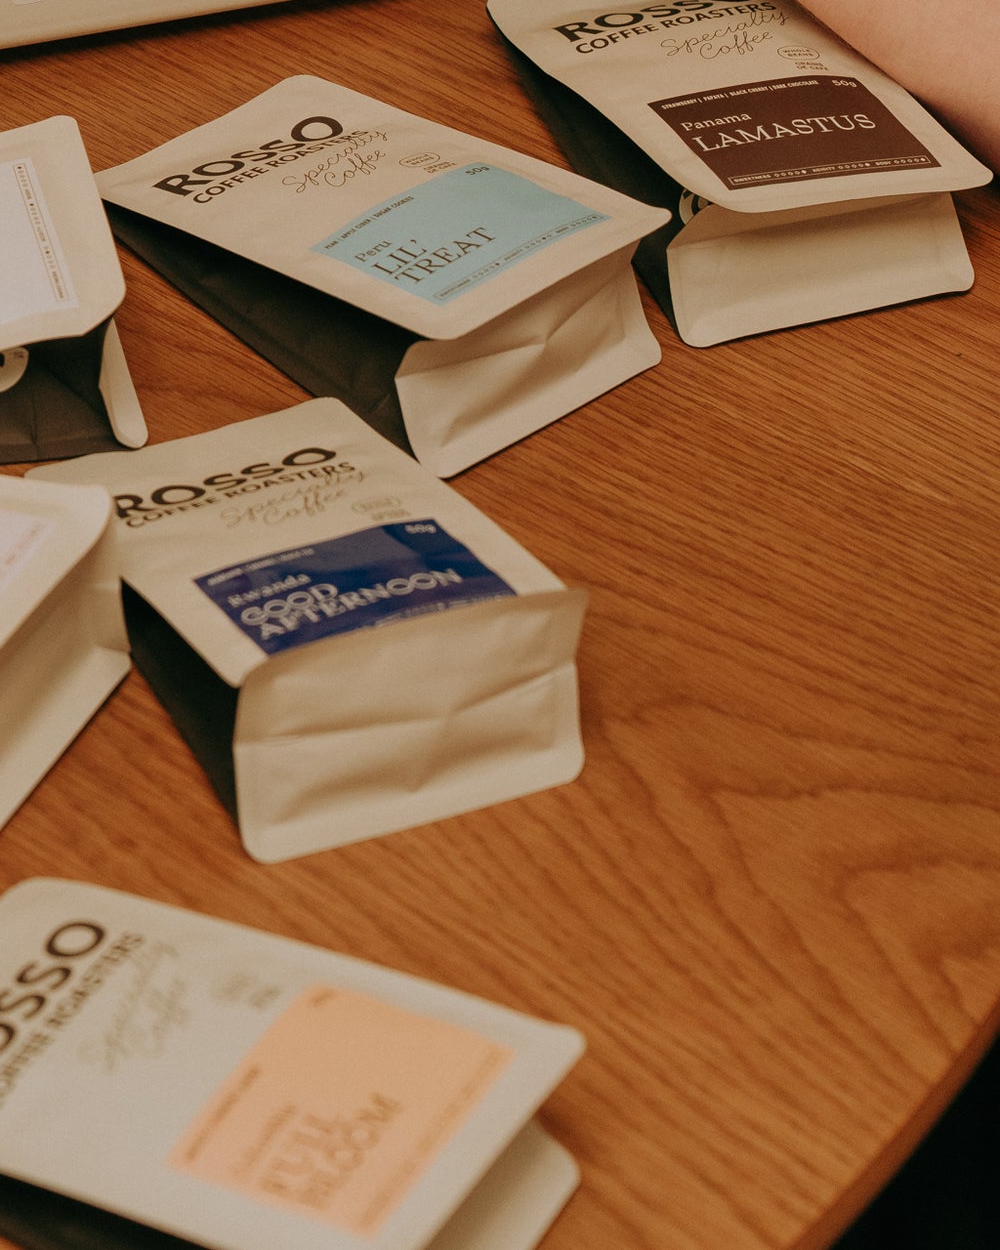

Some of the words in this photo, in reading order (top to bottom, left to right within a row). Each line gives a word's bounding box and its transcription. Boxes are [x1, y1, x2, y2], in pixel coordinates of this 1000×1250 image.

[576, 23, 659, 54] COFFEE
[659, 2, 777, 28] ROASTERS
[660, 11, 789, 57] Specialty
[699, 31, 773, 60] Coffee
[832, 79, 857, 88] 50g
[681, 112, 752, 131] Panama
[692, 113, 877, 152] LAMASTUS
[152, 116, 344, 197] ROSSO
[193, 166, 269, 204] COFFEE
[266, 130, 369, 169] ROASTERS
[282, 129, 388, 194] Specialty
[324, 149, 386, 188] Coffee
[354, 240, 392, 262] Peru
[394, 226, 496, 284] TREAT
[113, 447, 337, 518] ROSSO
[126, 496, 217, 528] COFFEE
[224, 461, 356, 499] ROASTERS
[228, 573, 312, 608] Rwanda
[241, 583, 338, 626] GOOD
[258, 568, 463, 640] AFTERNOON
